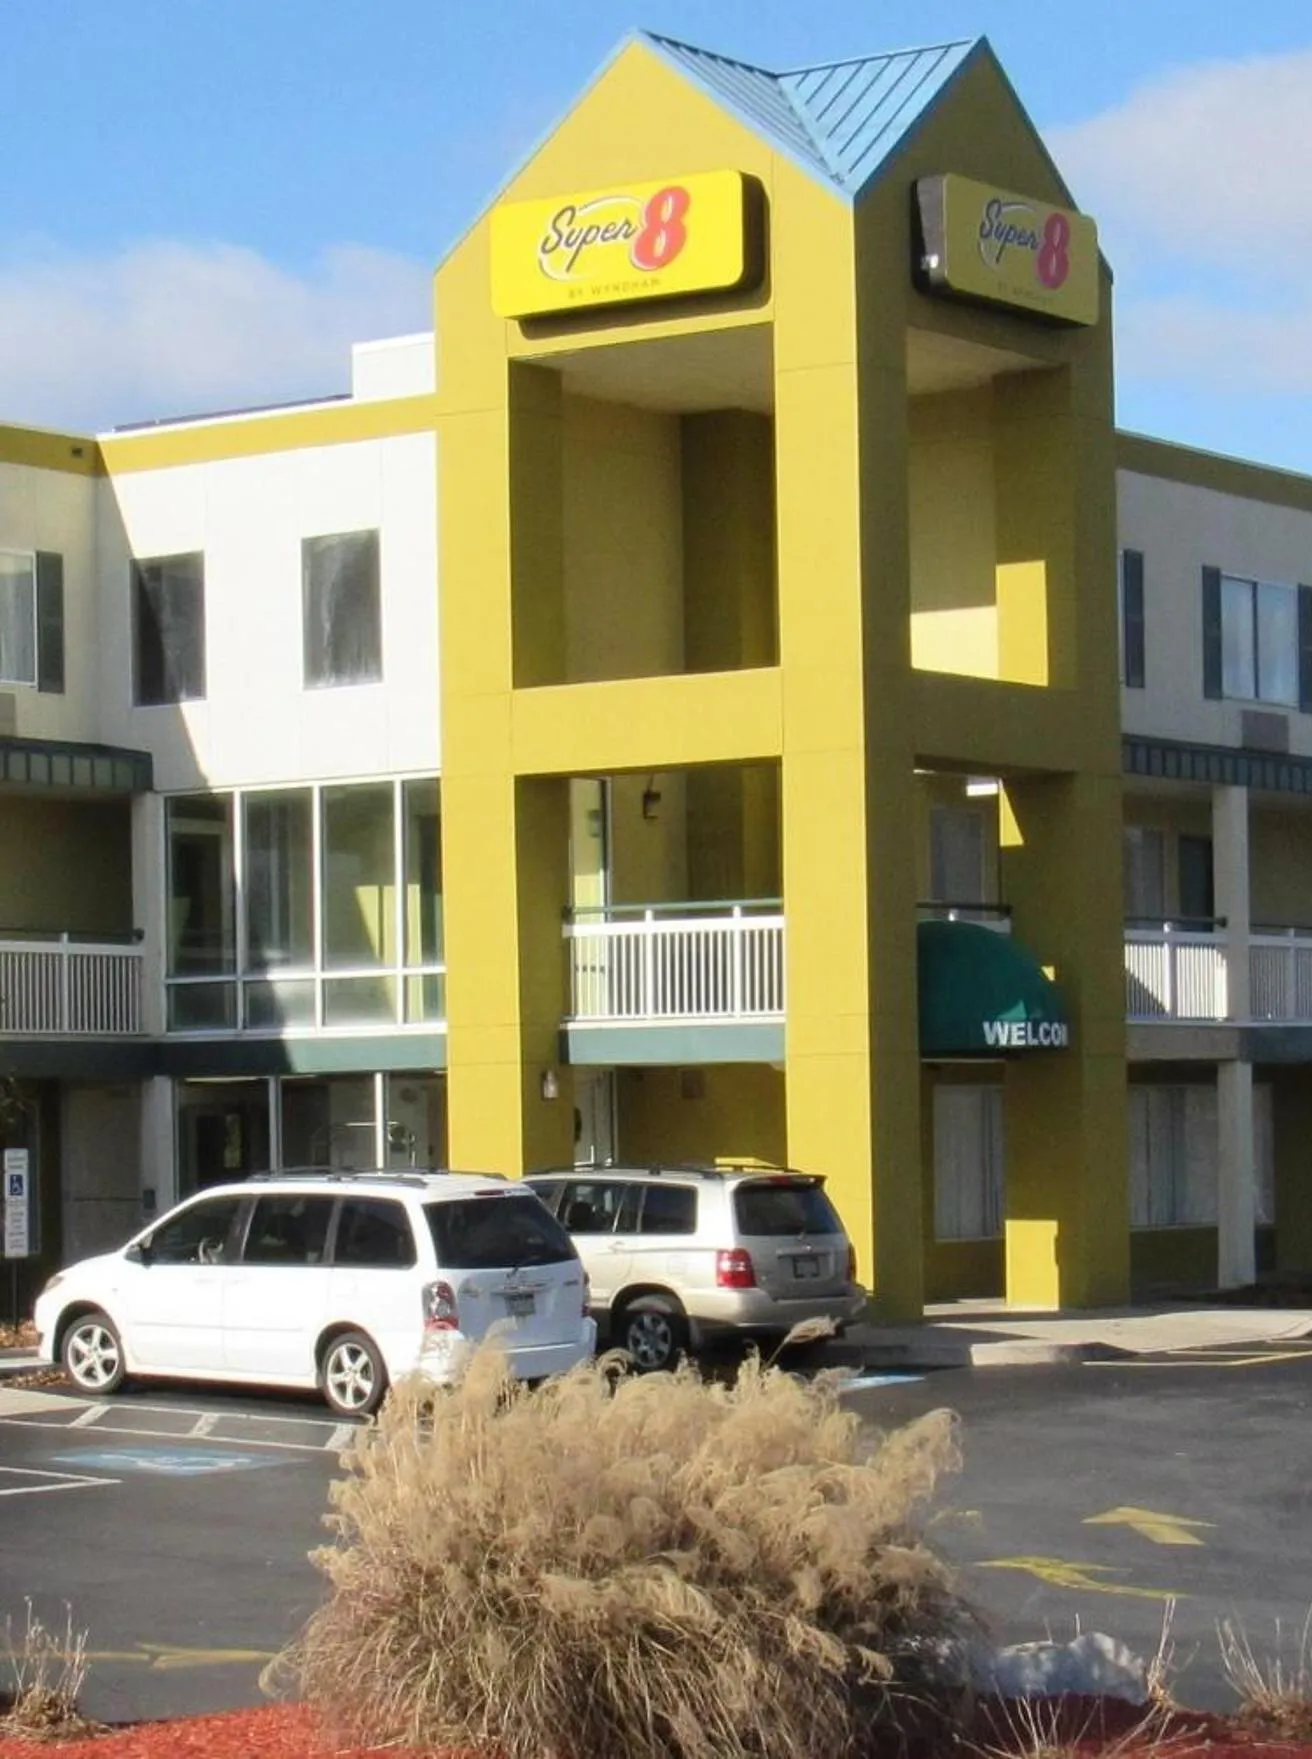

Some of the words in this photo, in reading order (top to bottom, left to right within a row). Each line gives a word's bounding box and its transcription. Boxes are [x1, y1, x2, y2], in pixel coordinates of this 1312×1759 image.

[541, 205, 638, 273] Super
[631, 185, 691, 271] 8
[979, 197, 1039, 264] Super
[1037, 212, 1070, 290] 8
